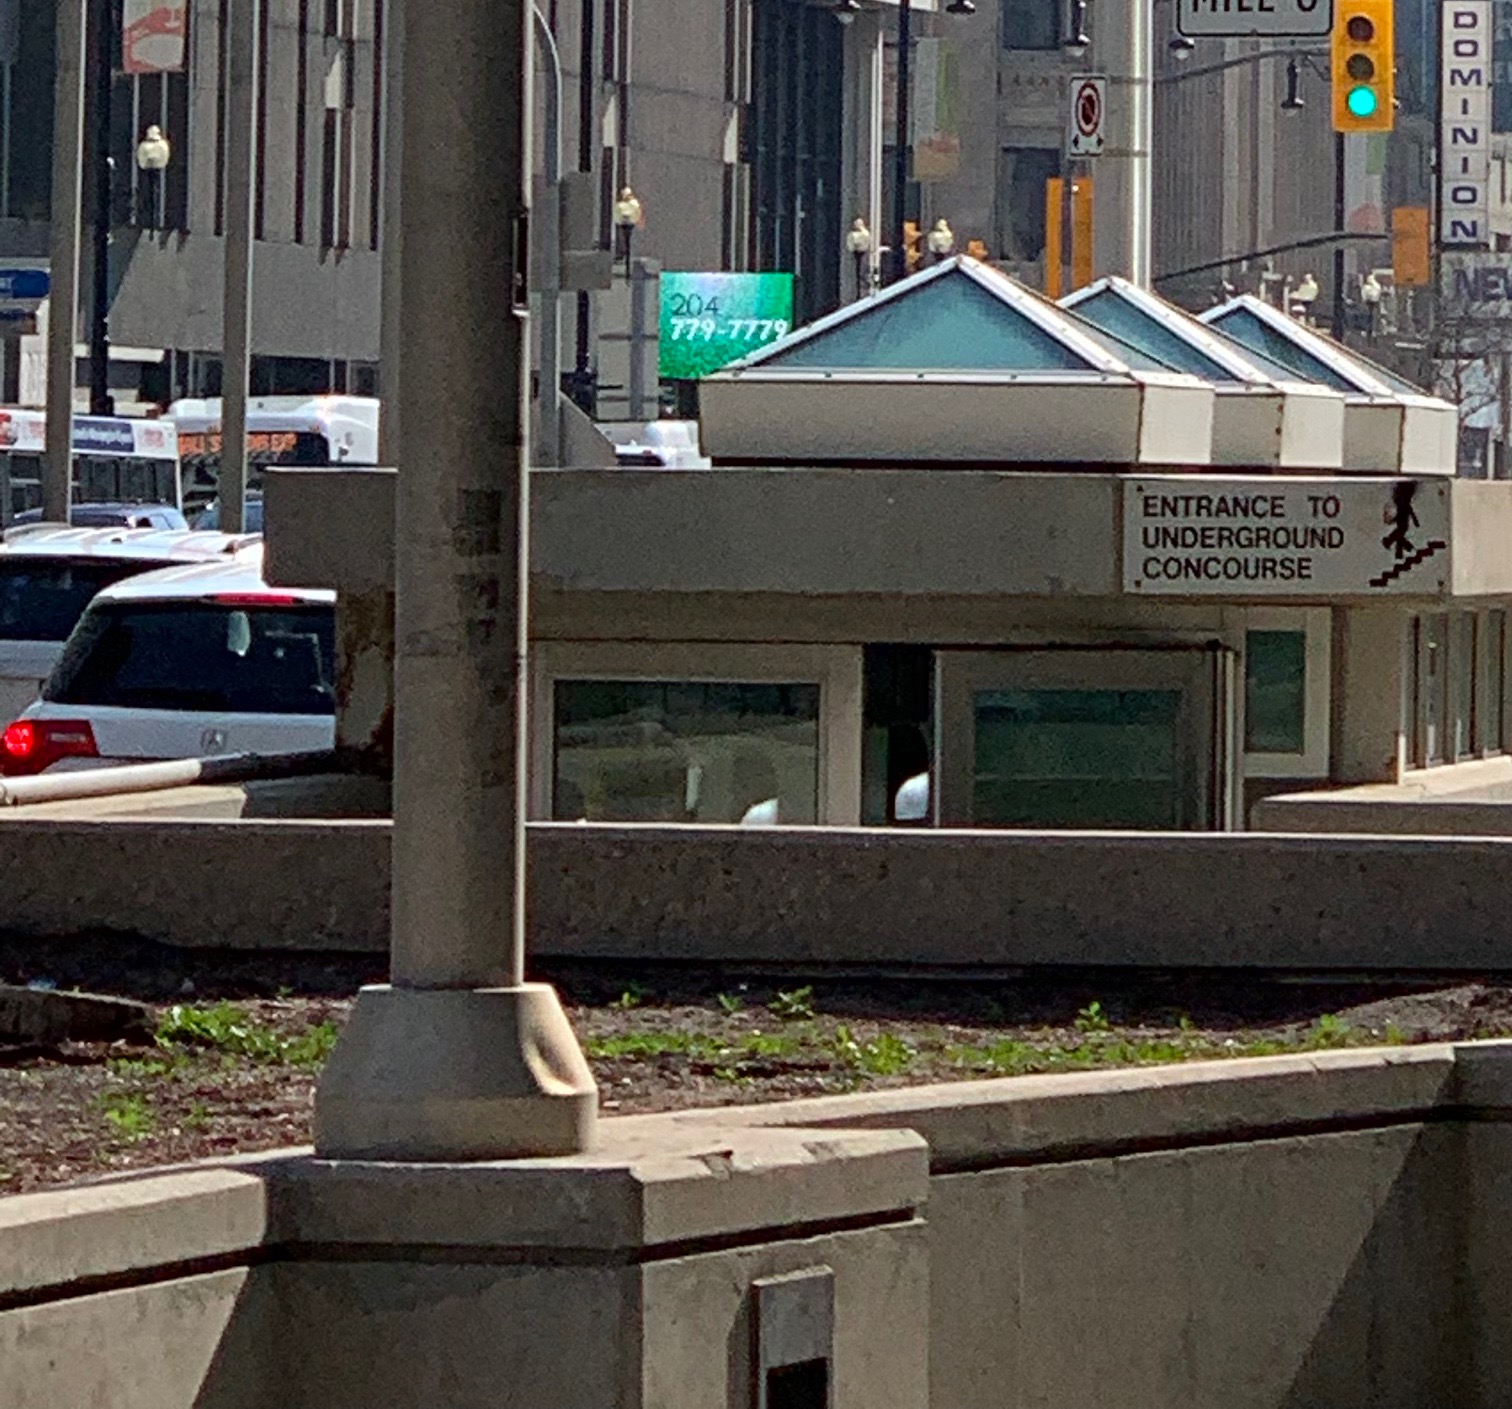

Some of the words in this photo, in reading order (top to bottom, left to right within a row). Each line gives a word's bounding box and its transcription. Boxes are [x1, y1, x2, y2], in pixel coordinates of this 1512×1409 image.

[1449, 10, 1483, 239] DOMINION
[670, 292, 720, 316] 204
[670, 318, 788, 341] 779-7779
[1142, 495, 1285, 518] ENTRANCE
[1308, 495, 1341, 518] TO
[1142, 526, 1344, 550] UNDERGROUND
[1142, 557, 1312, 581] CONCOURSE
